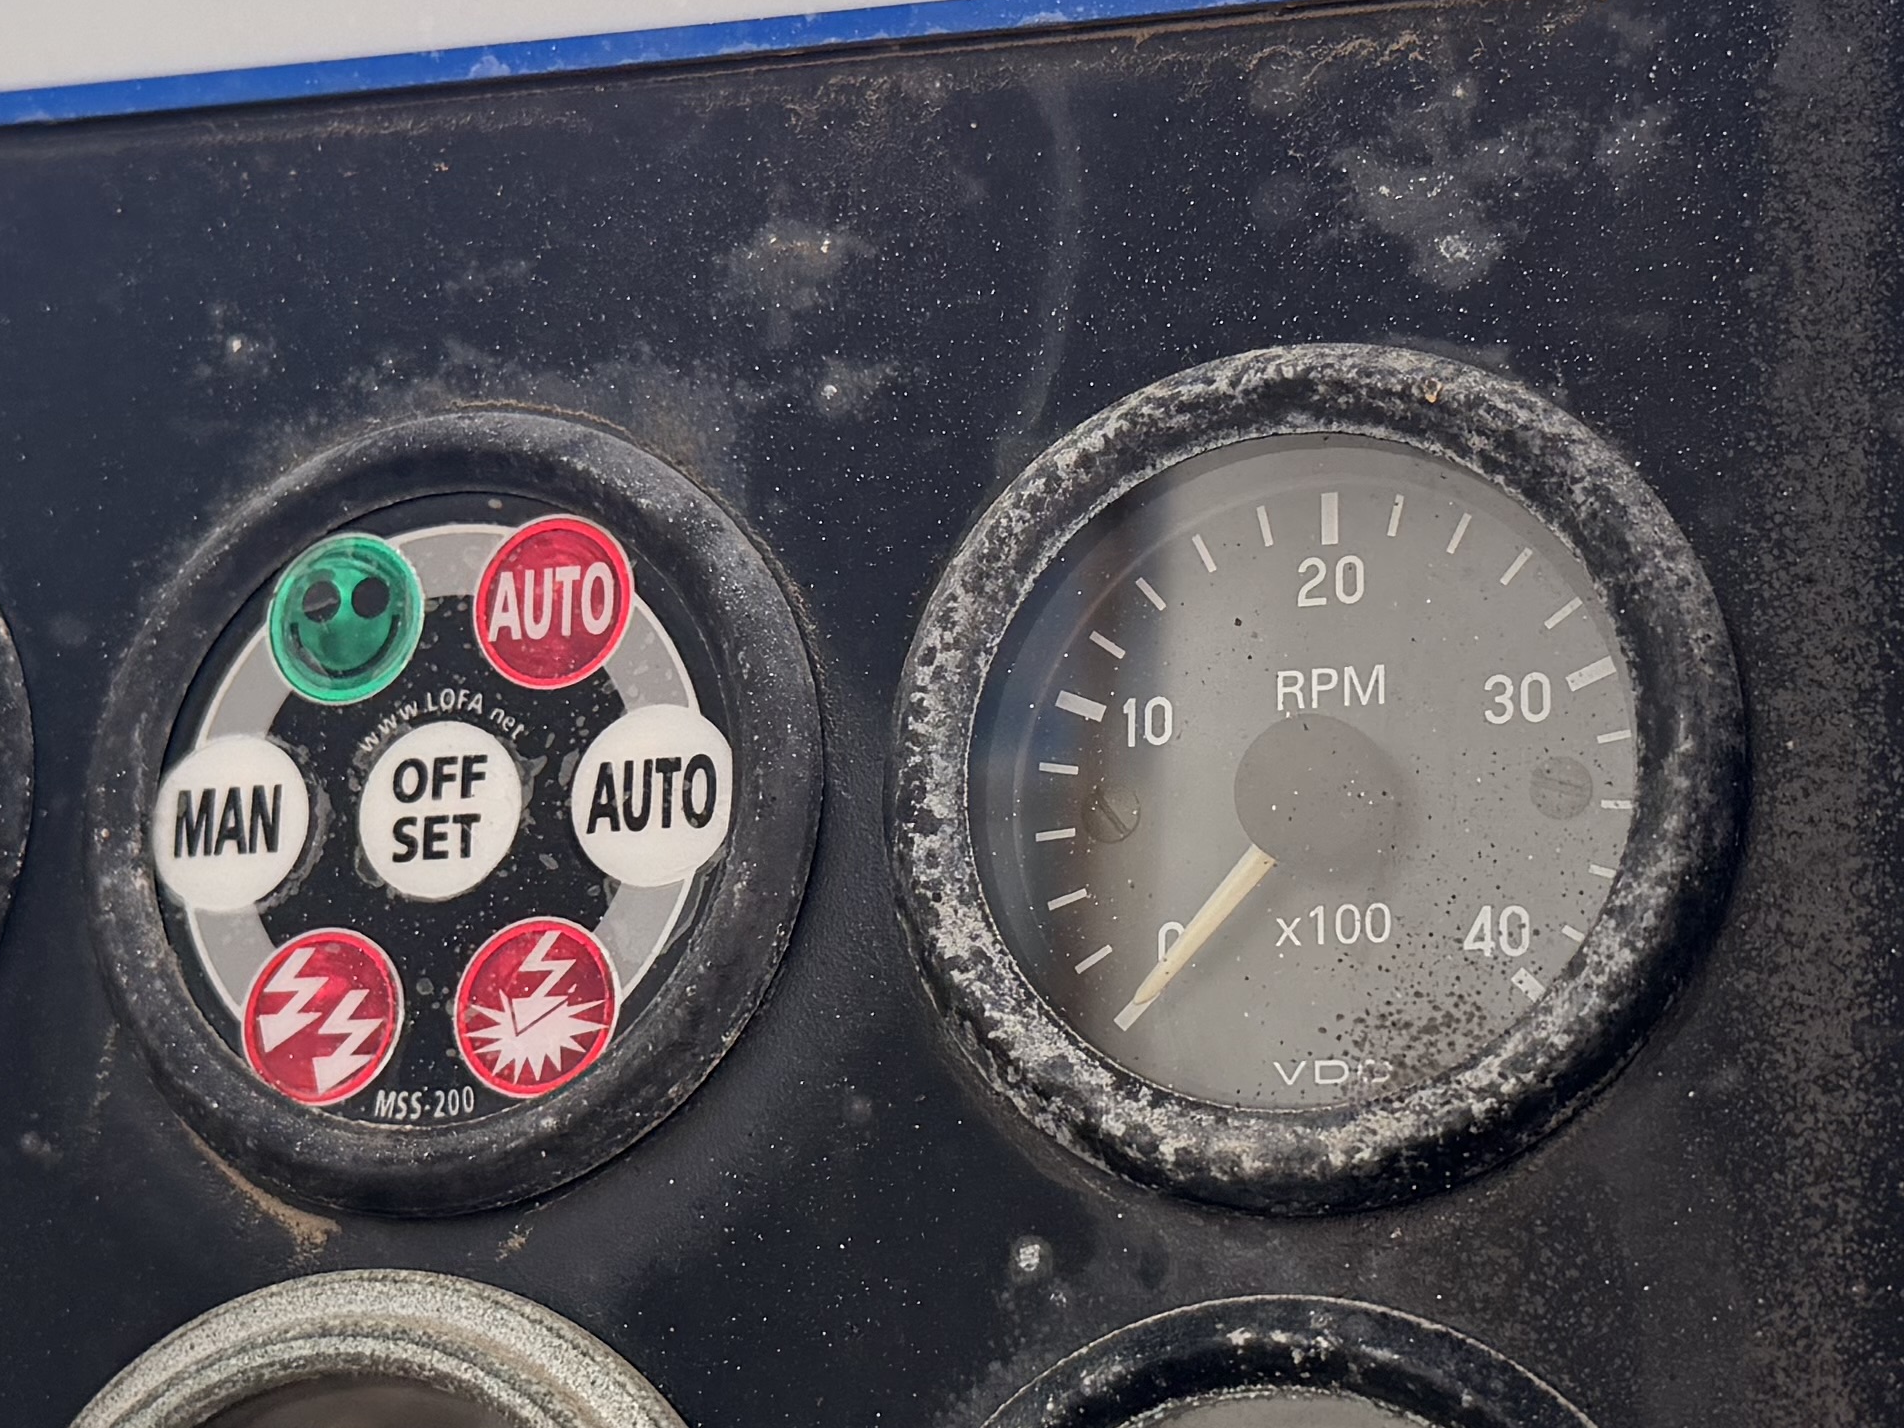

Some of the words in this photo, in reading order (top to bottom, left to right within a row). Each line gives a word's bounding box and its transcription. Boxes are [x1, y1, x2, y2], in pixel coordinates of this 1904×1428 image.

[489, 561, 614, 643] AUTO
[1297, 555, 1366, 608] 20
[1276, 663, 1387, 715] RPM
[1484, 672, 1551, 725] 30
[1122, 696, 1173, 748] 10
[393, 754, 487, 803] OFF
[586, 754, 717, 834] AUTO
[173, 785, 283, 858] MAN
[392, 814, 482, 864] SET
[1275, 903, 1392, 947] x100
[1463, 906, 1532, 958] 40
[374, 1085, 476, 1119] MSS-200
